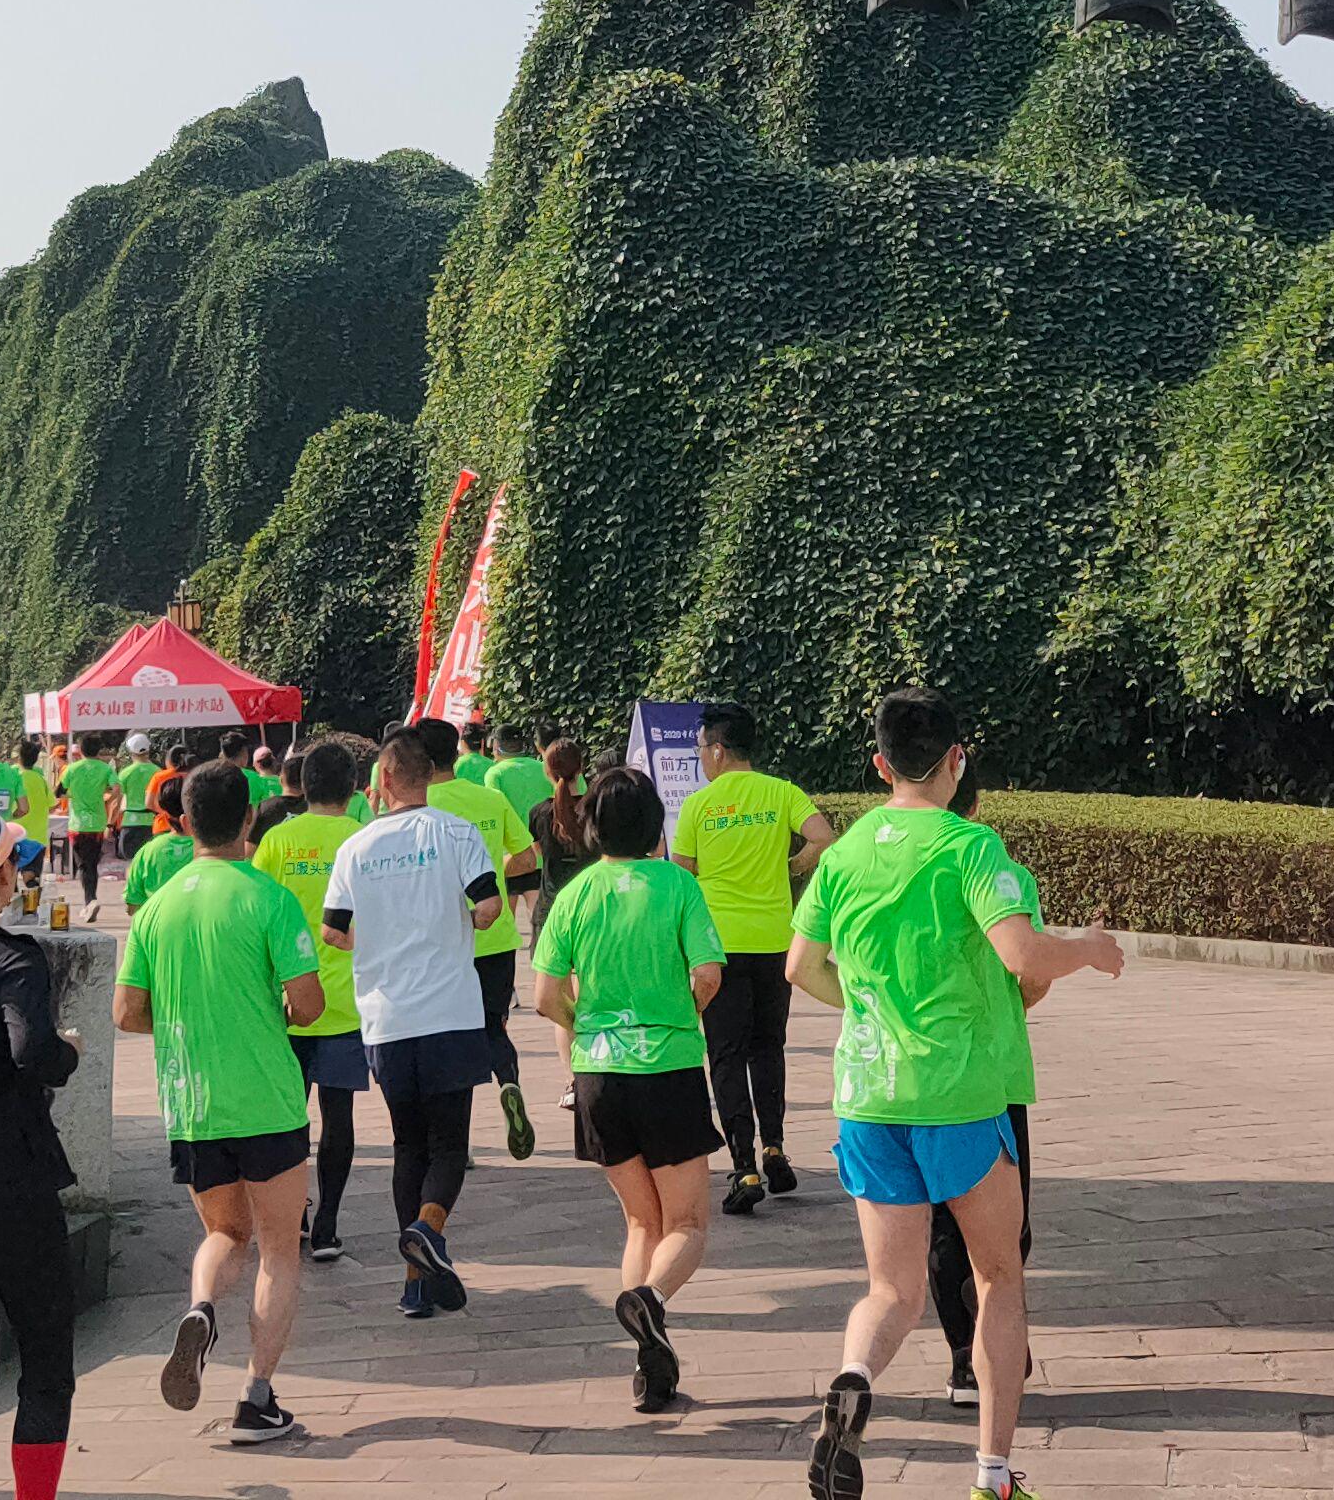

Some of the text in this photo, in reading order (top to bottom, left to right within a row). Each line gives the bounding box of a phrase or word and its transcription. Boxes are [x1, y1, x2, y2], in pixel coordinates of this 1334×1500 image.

[76, 697, 224, 716] 农夫山泉 健康补水站
[660, 756, 688, 772] 前方
[663, 774, 690, 783] AHEAD
